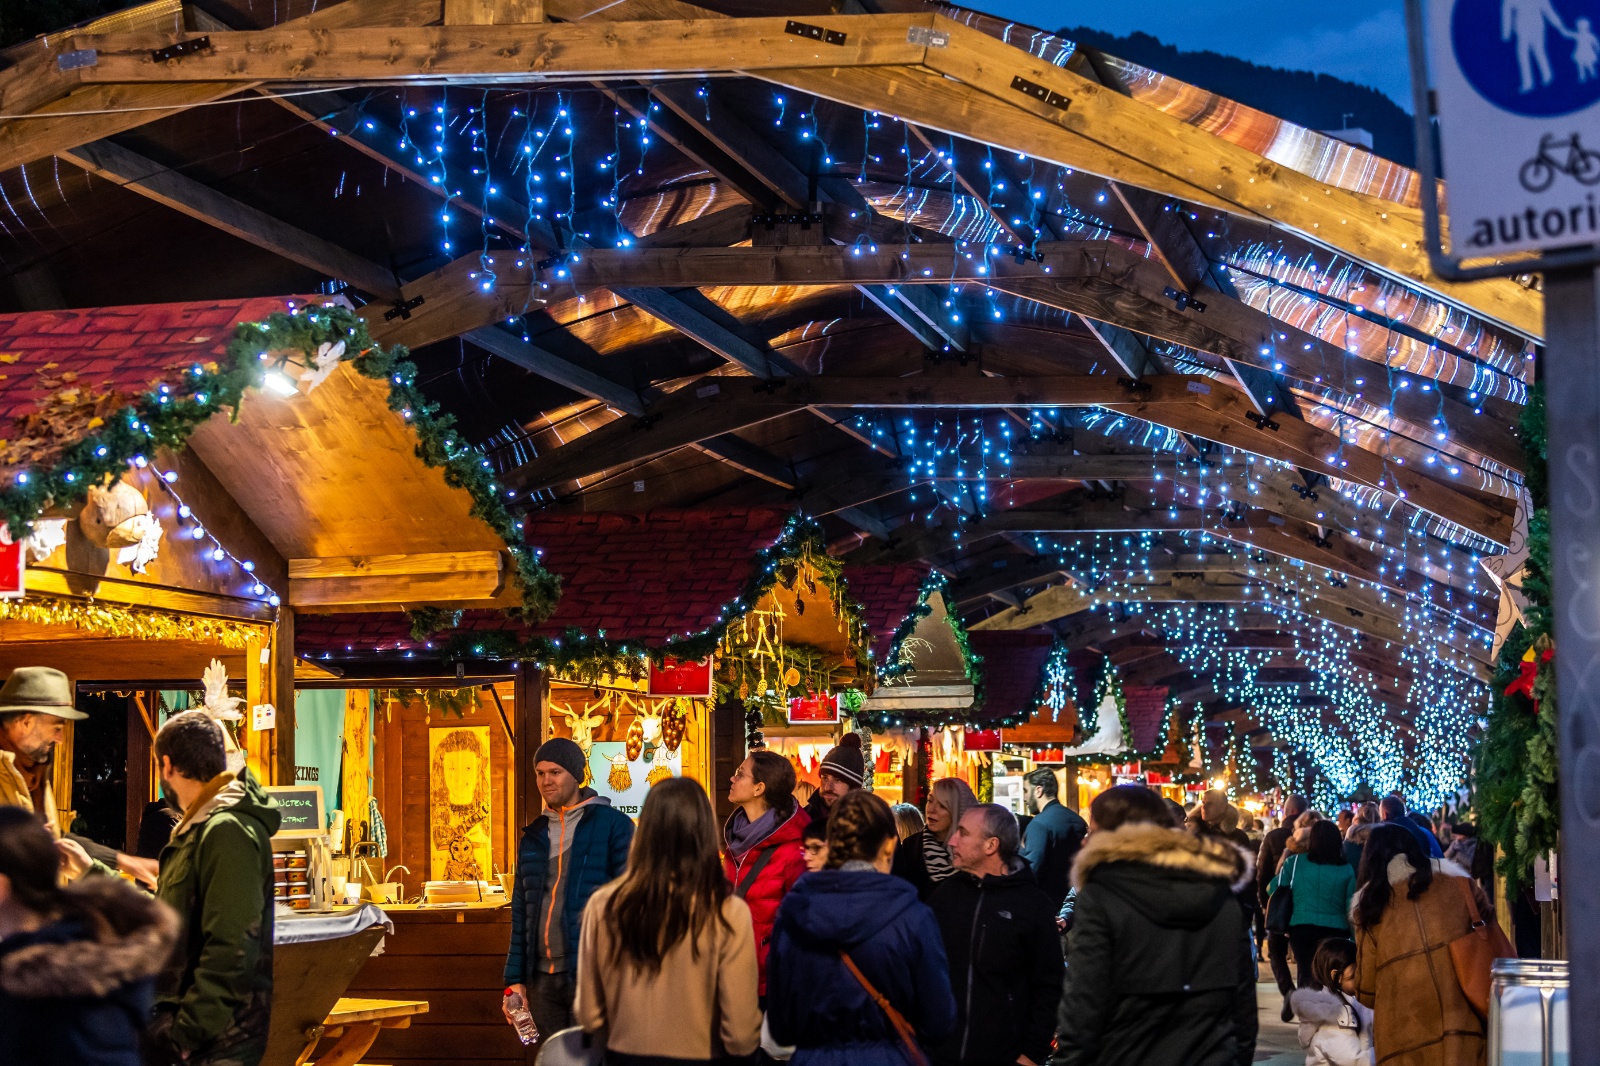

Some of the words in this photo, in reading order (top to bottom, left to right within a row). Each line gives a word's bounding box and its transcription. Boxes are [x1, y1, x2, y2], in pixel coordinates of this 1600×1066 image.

[1469, 192, 1600, 247] autori
[295, 766, 319, 781] KINGS
[278, 799, 313, 807] UCTEUR
[619, 805, 638, 814] DES
